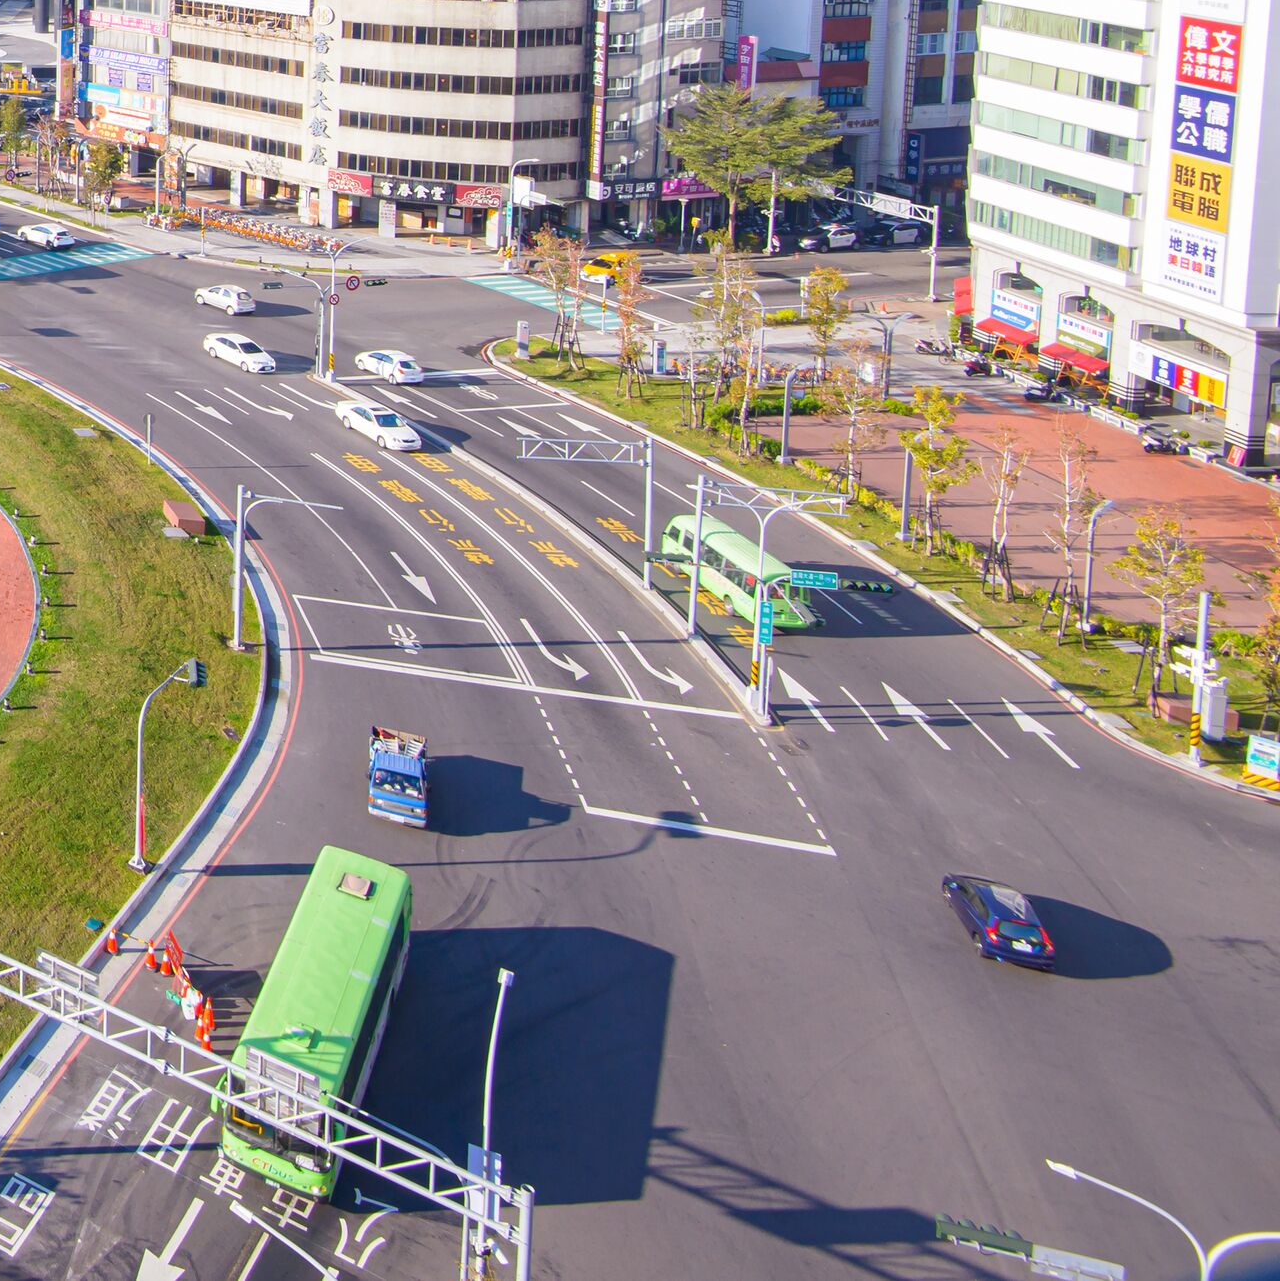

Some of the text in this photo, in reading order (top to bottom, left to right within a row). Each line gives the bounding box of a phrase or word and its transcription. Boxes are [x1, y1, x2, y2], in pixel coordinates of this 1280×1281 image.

[1184, 25, 1236, 55] 偉文
[1182, 63, 1234, 85] 升研究所
[309, 32, 335, 166] 富春大飯店
[1178, 94, 1231, 127] 學儒
[1176, 121, 1228, 154] 公職
[380, 181, 446, 201] 富春食堂
[1174, 163, 1222, 196] 聯成
[1172, 188, 1219, 222] 電腦
[1168, 235, 1217, 263] 地球村
[1167, 253, 1216, 279] 美日韓語
[251, 1156, 295, 1183] CTbus
